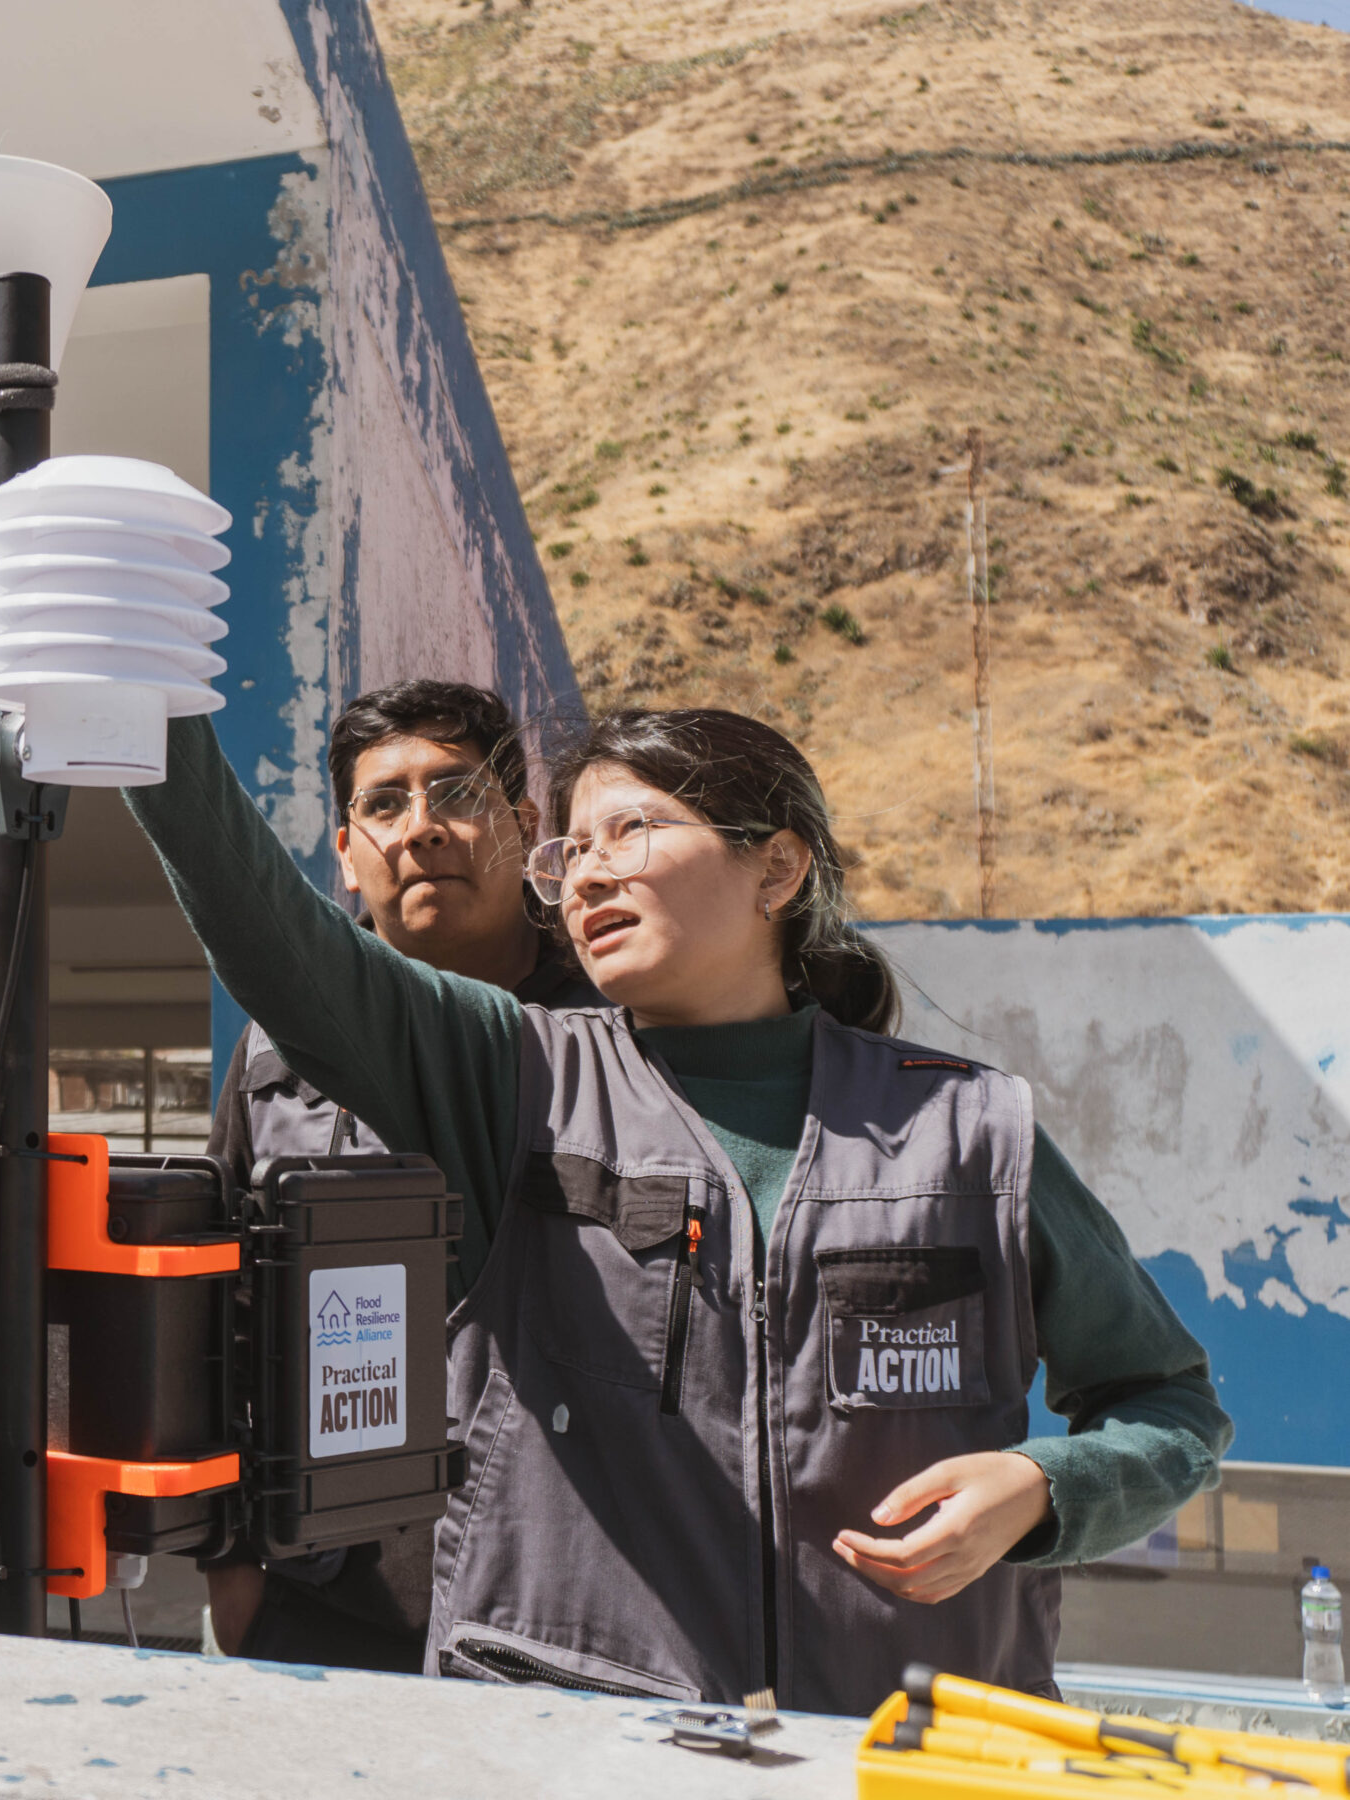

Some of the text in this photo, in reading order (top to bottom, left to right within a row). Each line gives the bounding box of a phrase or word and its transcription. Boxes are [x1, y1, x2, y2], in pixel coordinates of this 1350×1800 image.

[356, 1294, 381, 1309] Flood
[356, 1311, 400, 1326] Resilience
[858, 1318, 958, 1345] Practical
[356, 1328, 393, 1342] Alliance
[322, 1356, 397, 1386] Practical
[857, 1347, 961, 1394] ACTION
[320, 1385, 397, 1434] ACTION
